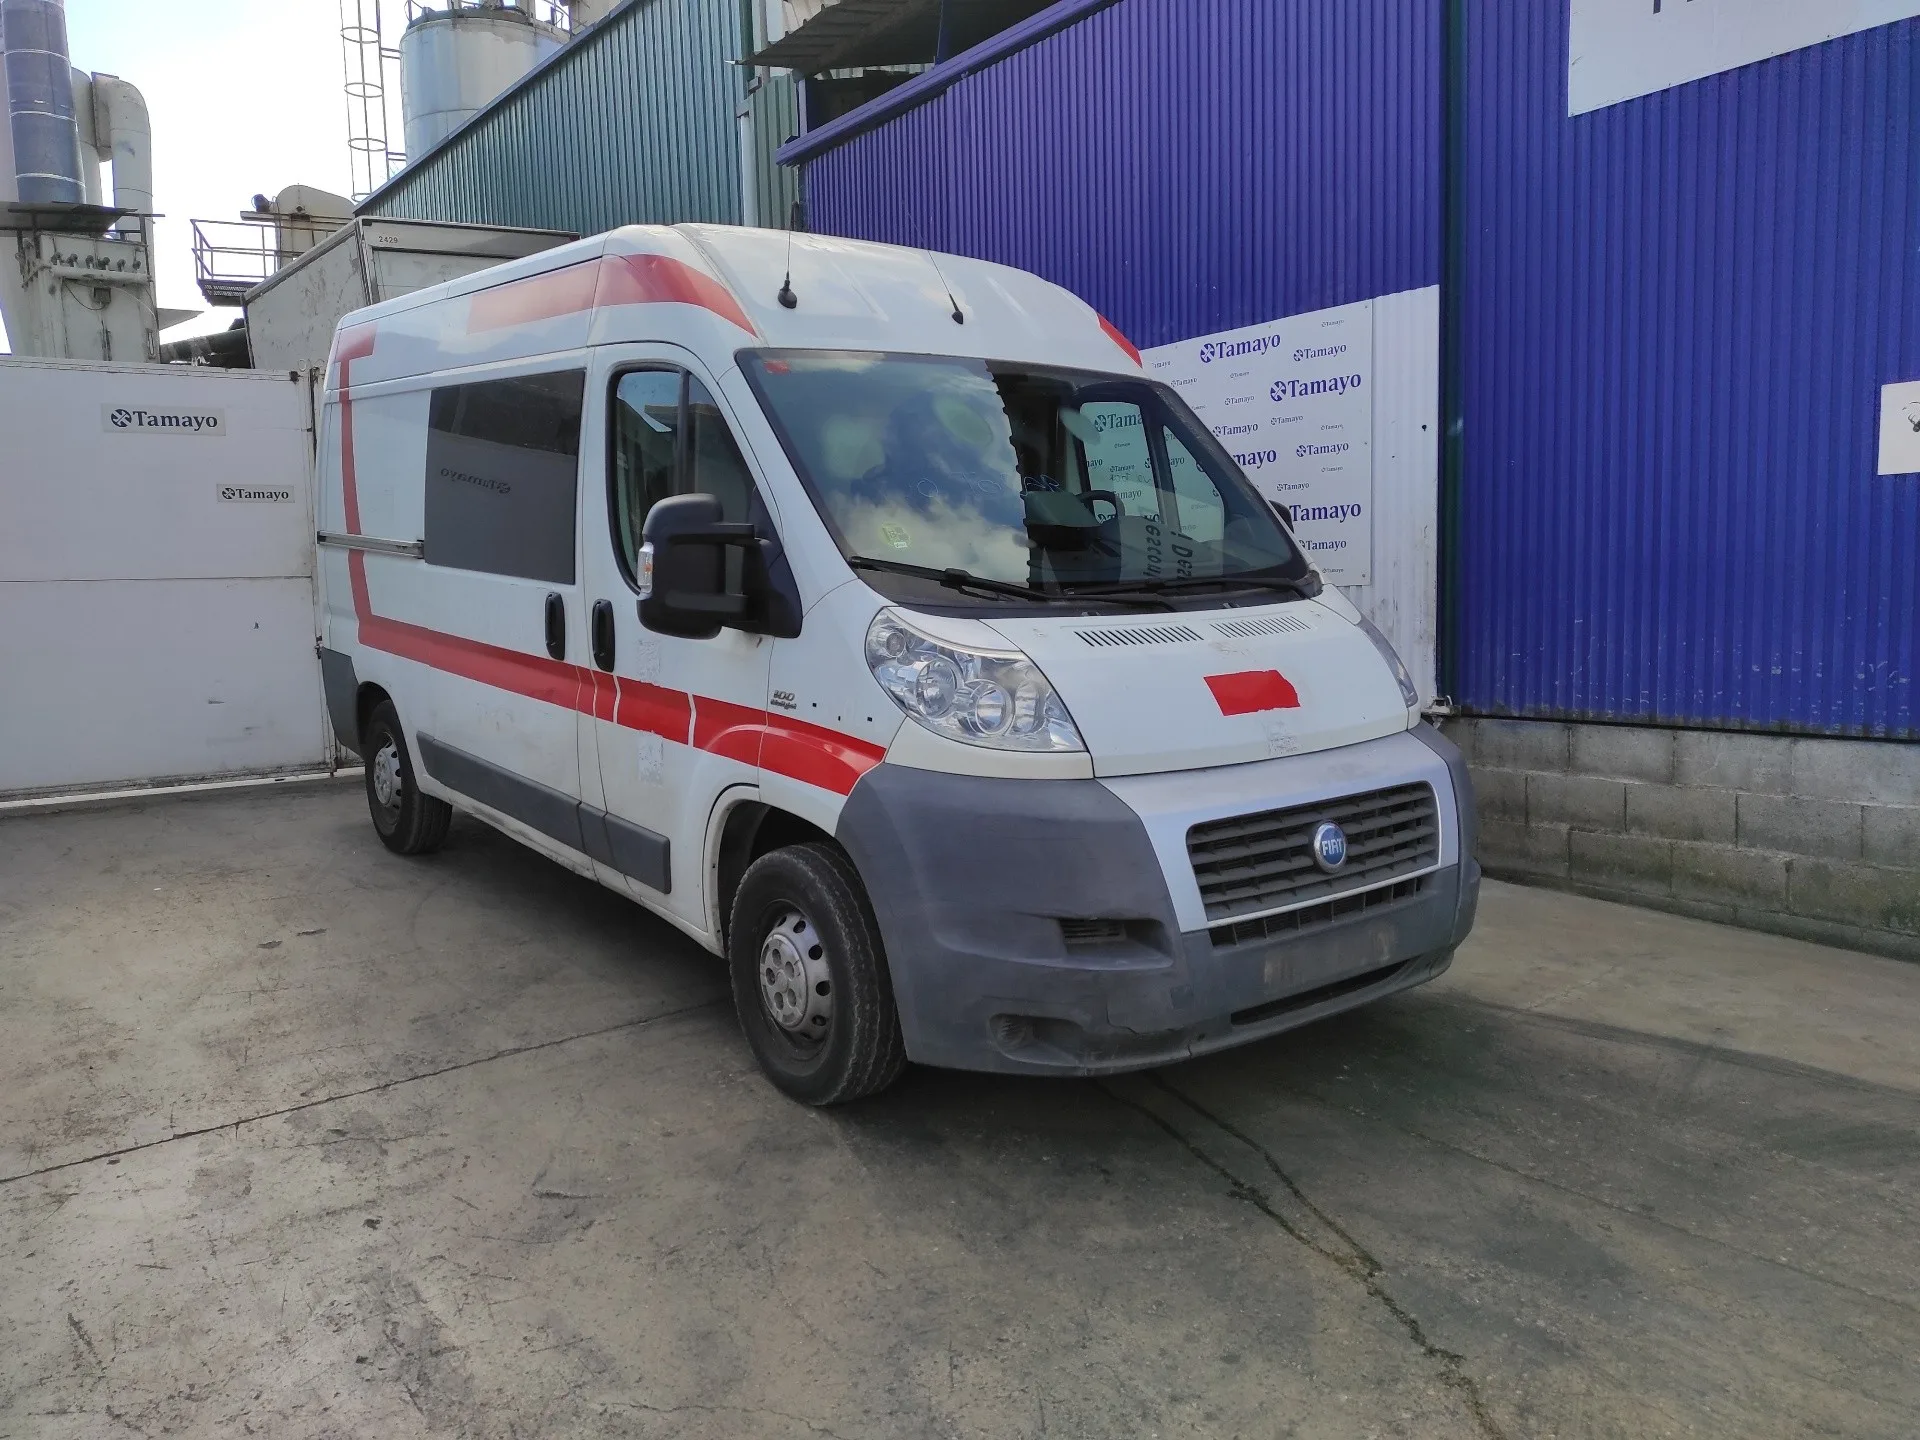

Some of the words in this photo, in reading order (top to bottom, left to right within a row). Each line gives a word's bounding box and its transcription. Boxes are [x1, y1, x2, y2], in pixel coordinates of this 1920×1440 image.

[1216, 334, 1281, 359] Tamayo
[1304, 344, 1347, 359] Tamayo
[1176, 378, 1197, 386] Tamayo
[1287, 373, 1362, 398] Tamayo
[1231, 396, 1254, 404] Tamayo
[132, 411, 218, 431] Tamayo
[1107, 413, 1143, 430] Tama
[1277, 415, 1303, 424] Tamayo
[1222, 424, 1258, 436] Tamayo
[1306, 443, 1349, 455] Tamayo
[1233, 449, 1277, 469] mayo
[236, 488, 289, 502] Tamayo
[1289, 503, 1362, 523] Tamayo
[1306, 540, 1347, 551] Tamayo
[1322, 838, 1342, 856] FIAT
